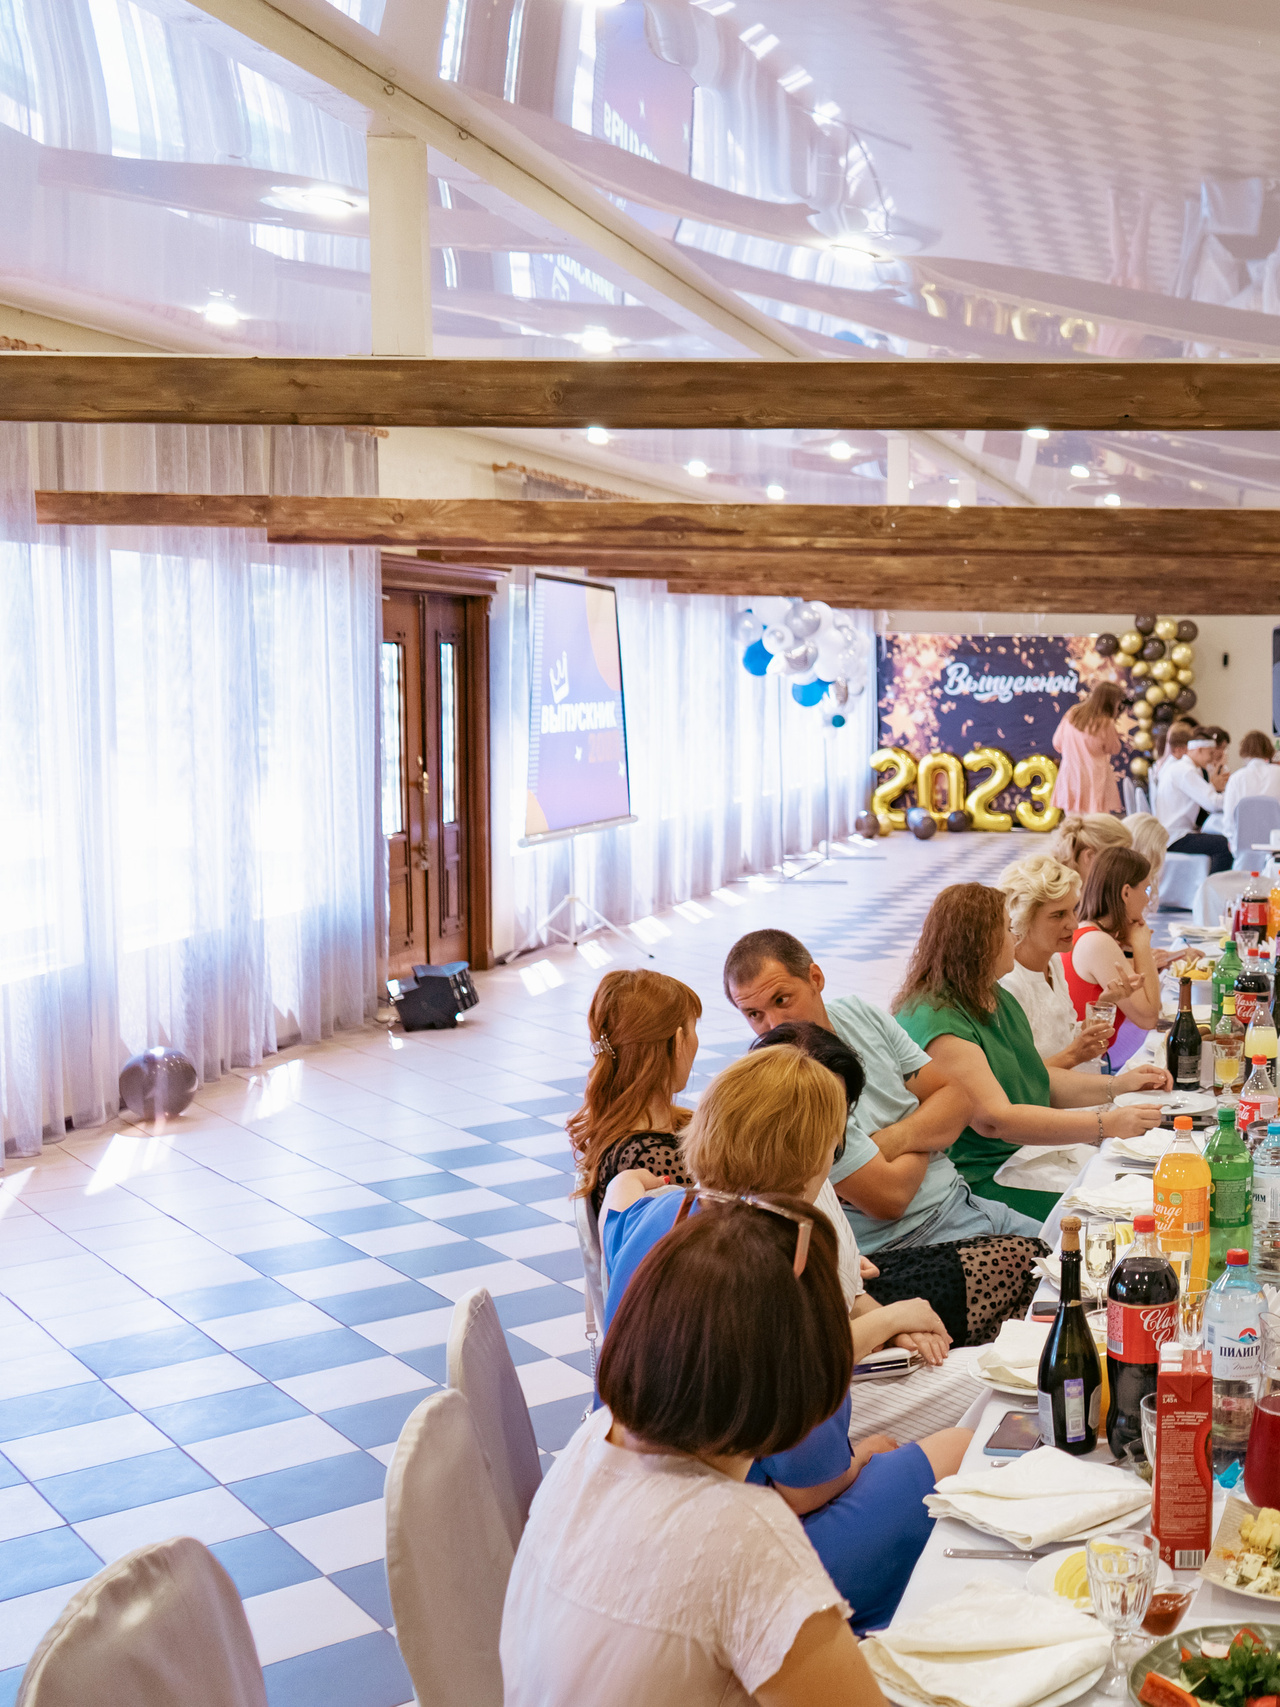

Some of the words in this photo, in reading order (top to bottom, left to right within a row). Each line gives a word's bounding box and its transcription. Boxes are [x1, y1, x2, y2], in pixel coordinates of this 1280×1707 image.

[944, 662, 1079, 704] Выпускной
[540, 700, 618, 734] ВЫПУСКНИК
[869, 748, 1061, 832] 2023
[1219, 1344, 1260, 1358] ПИЛИГР
